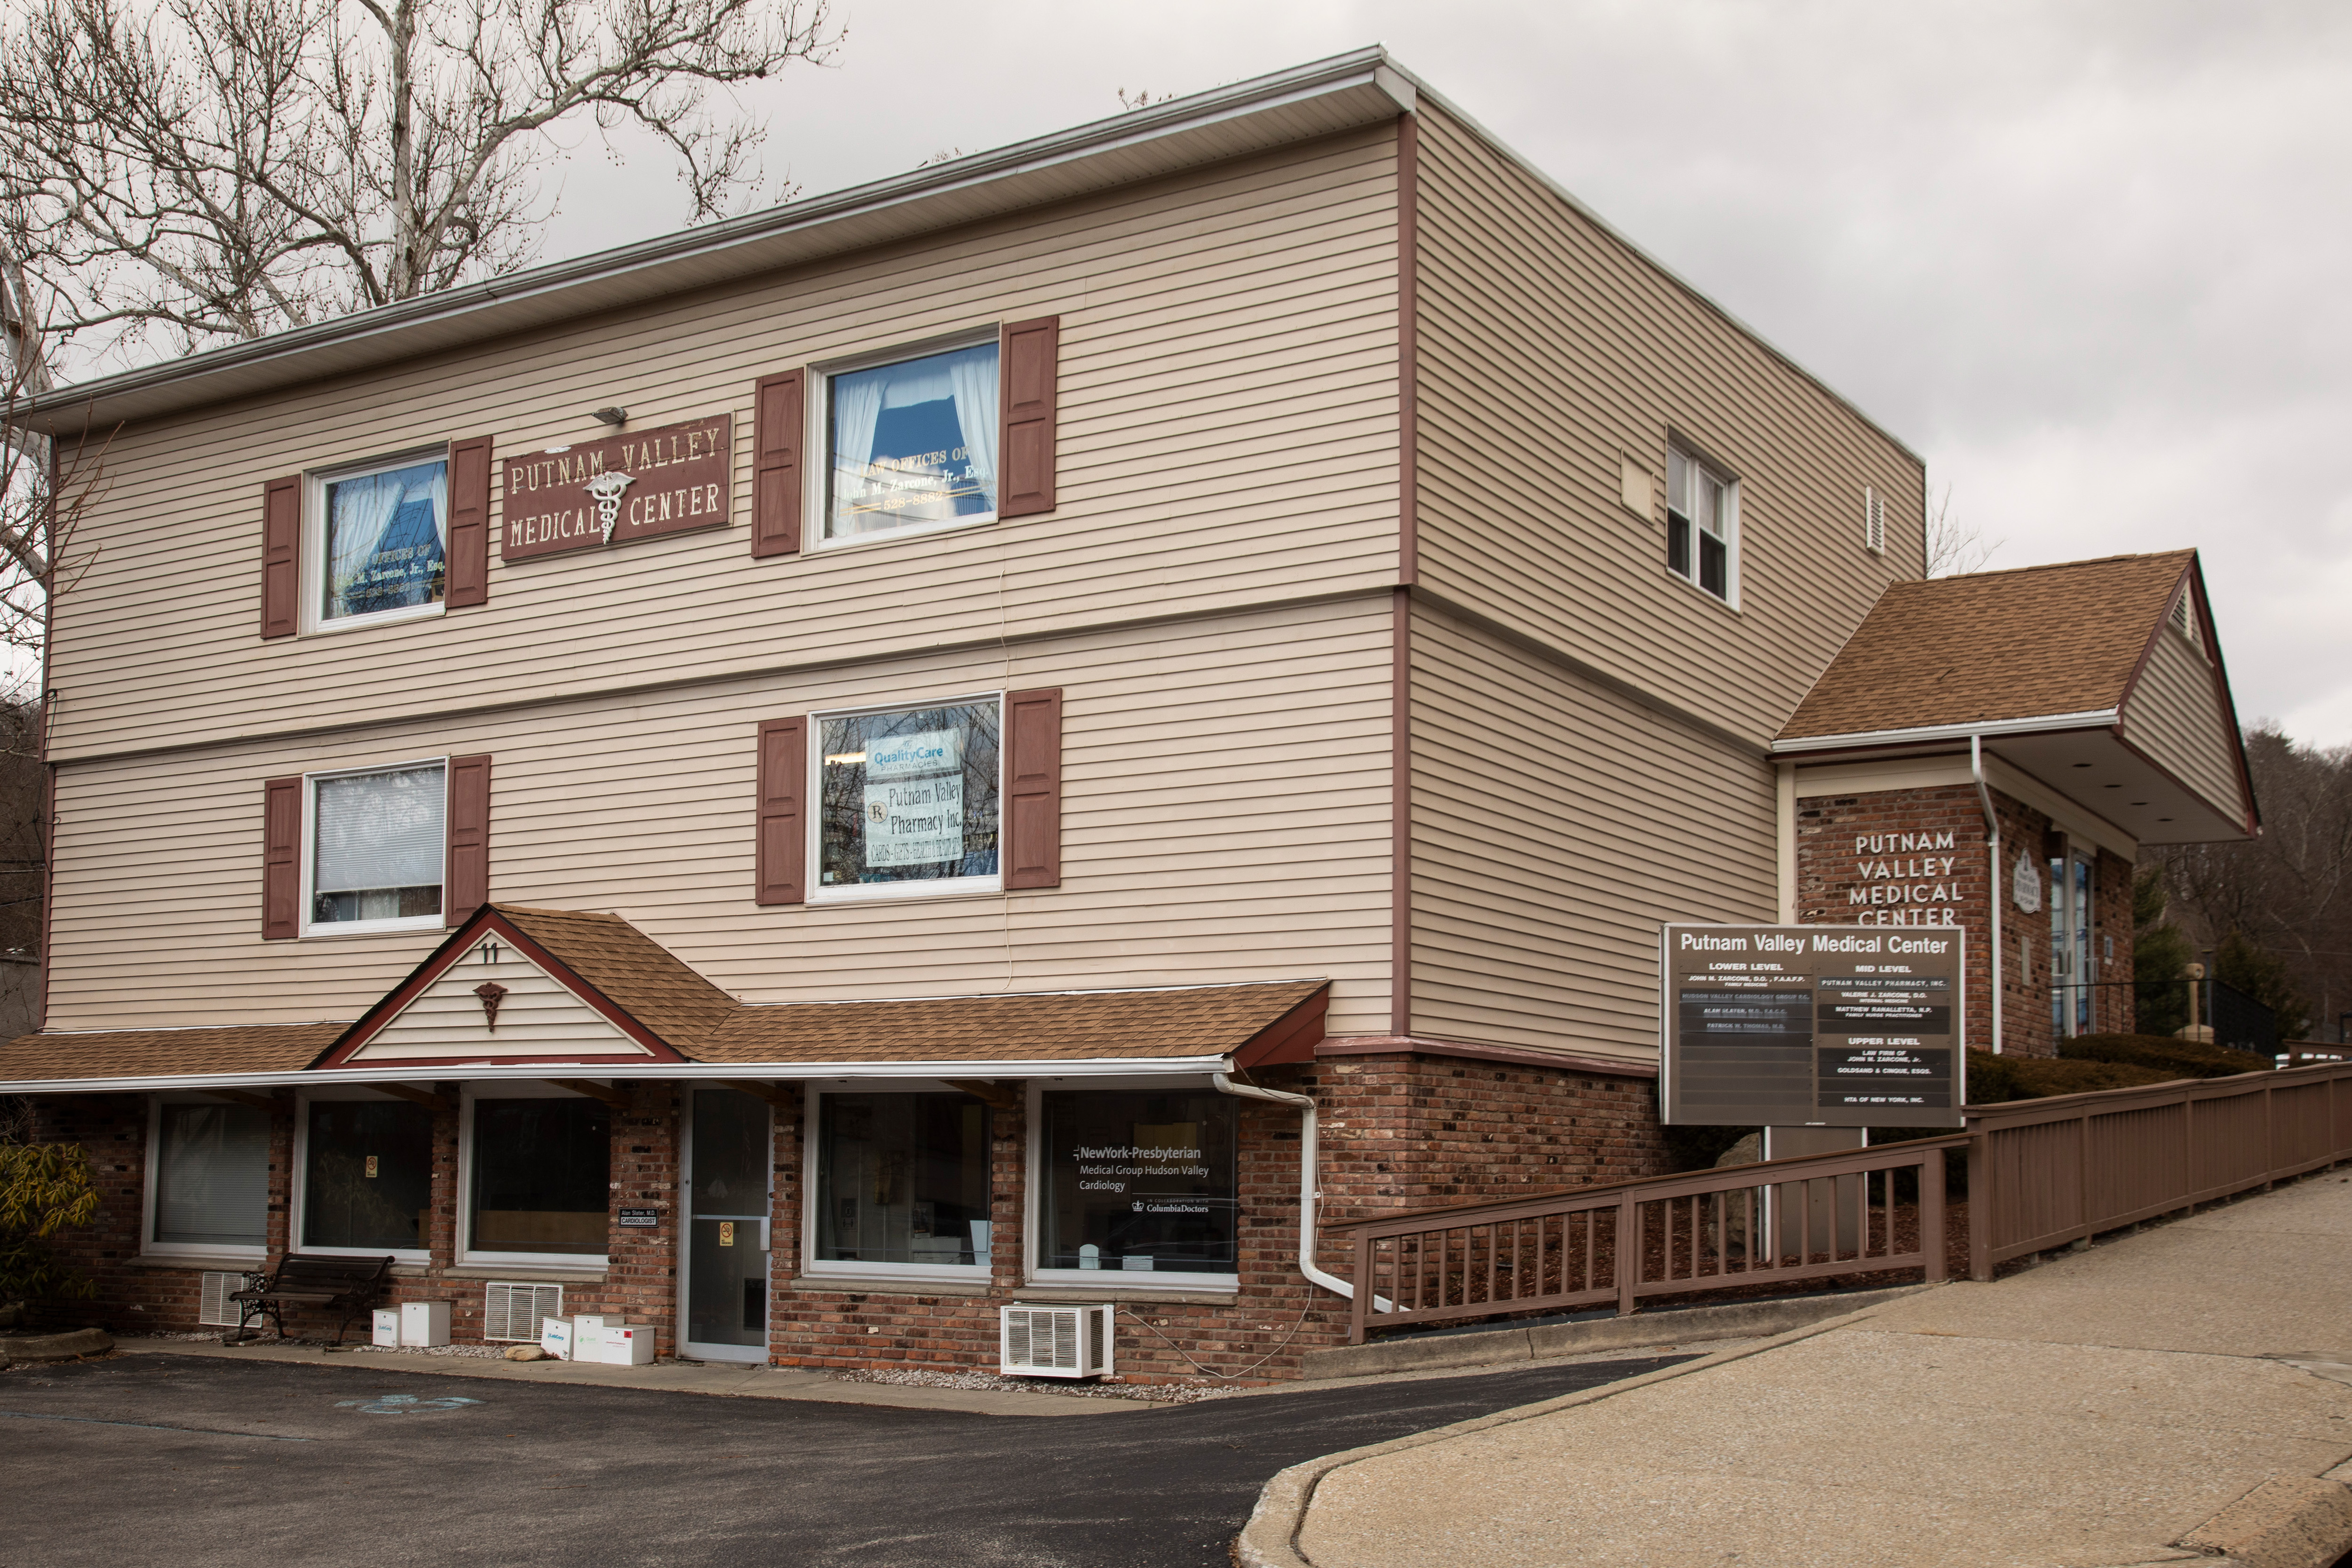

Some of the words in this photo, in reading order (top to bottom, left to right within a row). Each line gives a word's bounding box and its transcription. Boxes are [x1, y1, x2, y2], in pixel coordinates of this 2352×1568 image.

[511, 449, 604, 495] PUTNAM
[622, 427, 720, 473] VALLEY
[859, 460, 887, 478] LAW
[891, 449, 947, 472] OFFICES
[952, 446, 969, 461] OF
[842, 487, 866, 500] John
[872, 482, 885, 496] M.
[890, 475, 937, 493] Zarcone,
[942, 469, 960, 484] Jr.,
[964, 465, 989, 479] Esq.
[883, 491, 943, 511] 528-8882
[509, 505, 601, 548] MEDICAL
[629, 483, 719, 526] CENTER
[371, 546, 414, 565] OFFICES
[417, 543, 431, 557] OF
[357, 572, 368, 584] M.
[371, 567, 407, 582] Zarcone,
[410, 563, 424, 575] Jr.,
[427, 559, 445, 573] Esq.
[874, 746, 944, 766] QualityCare
[881, 759, 938, 772] PHARMACIES
[889, 787, 932, 807] Putnam
[935, 781, 961, 805] Valley
[890, 814, 944, 835] Pharmacy
[947, 809, 962, 828] Inc.
[871, 843, 890, 862] CARDS
[894, 842, 910, 861] GIFTS
[913, 840, 931, 860] HEALTH
[1856, 831, 1955, 855] PUTNAM
[1858, 856, 1955, 880] VALLEY
[1849, 882, 1964, 905] MEDICAL
[1858, 907, 1955, 926] CENTER
[481, 942, 497, 964] 11
[1681, 933, 1748, 951] Putnam
[1754, 934, 1806, 955] Valley
[1812, 934, 1881, 953] Medical
[1888, 935, 1948, 954] Center
[1081, 1146, 1201, 1162] NewYork-Presbyterian
[1080, 1165, 1113, 1175] Medical
[1116, 1165, 1143, 1177] Group
[1145, 1165, 1179, 1175] Hudson
[1181, 1165, 1209, 1178] Valley
[1080, 1180, 1125, 1193] Cardiology
[1146, 1203, 1209, 1212] ColumbiaDoctors
